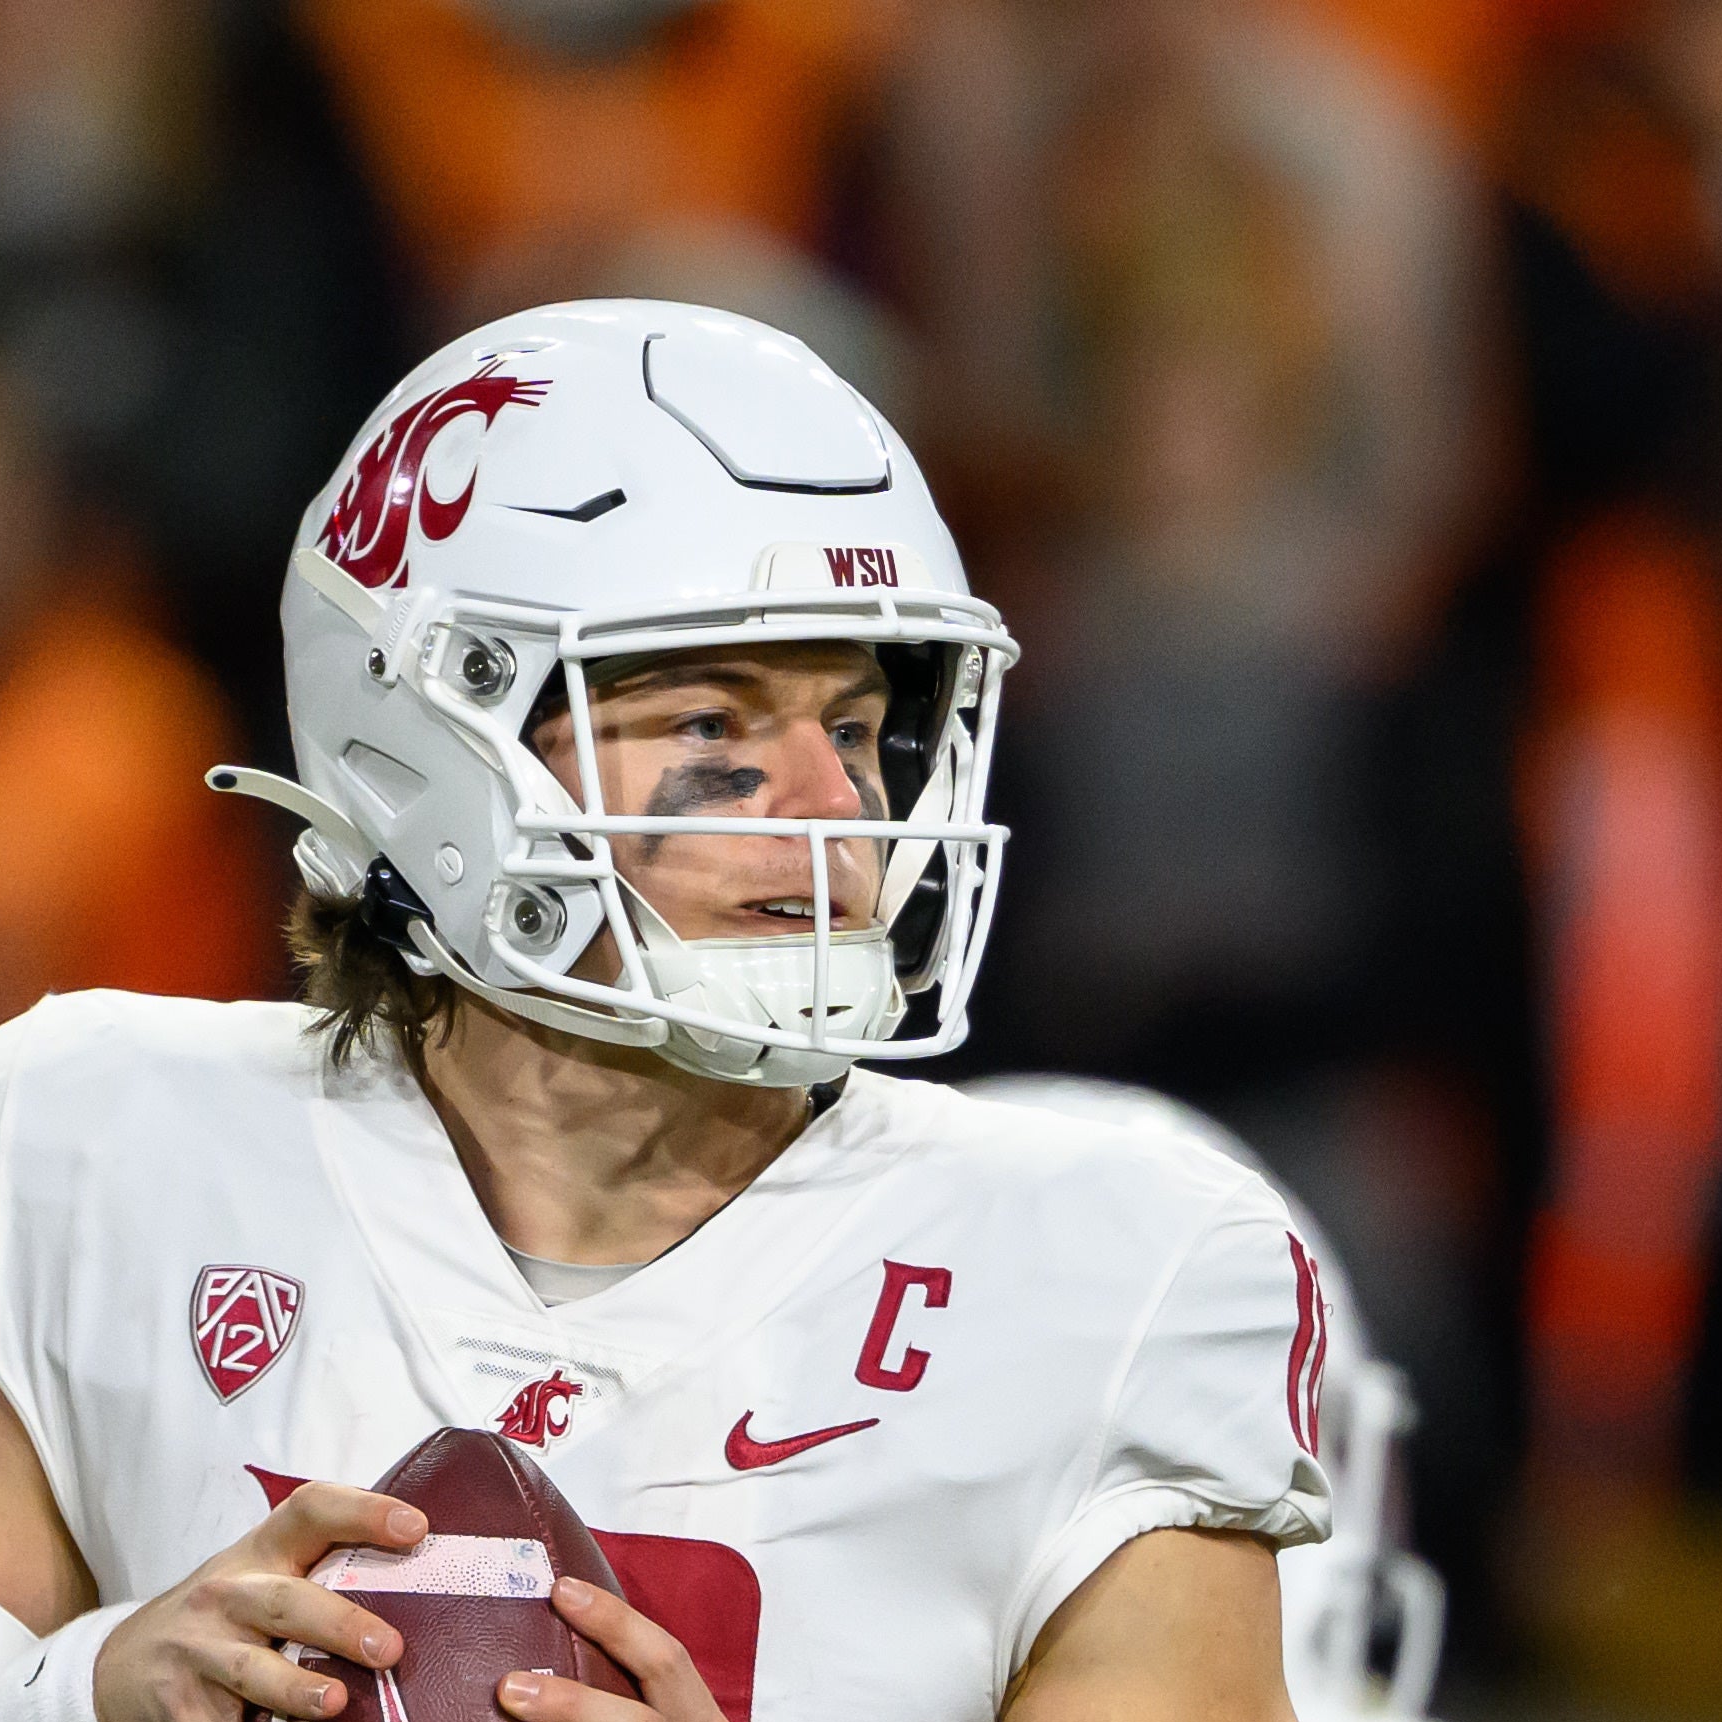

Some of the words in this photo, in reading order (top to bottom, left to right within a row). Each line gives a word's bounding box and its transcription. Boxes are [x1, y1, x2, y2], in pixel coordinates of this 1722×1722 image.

[822, 547, 899, 588] WSU
[196, 1270, 298, 1354] PAC
[854, 1258, 953, 1392] C
[209, 1321, 265, 1374] 12
